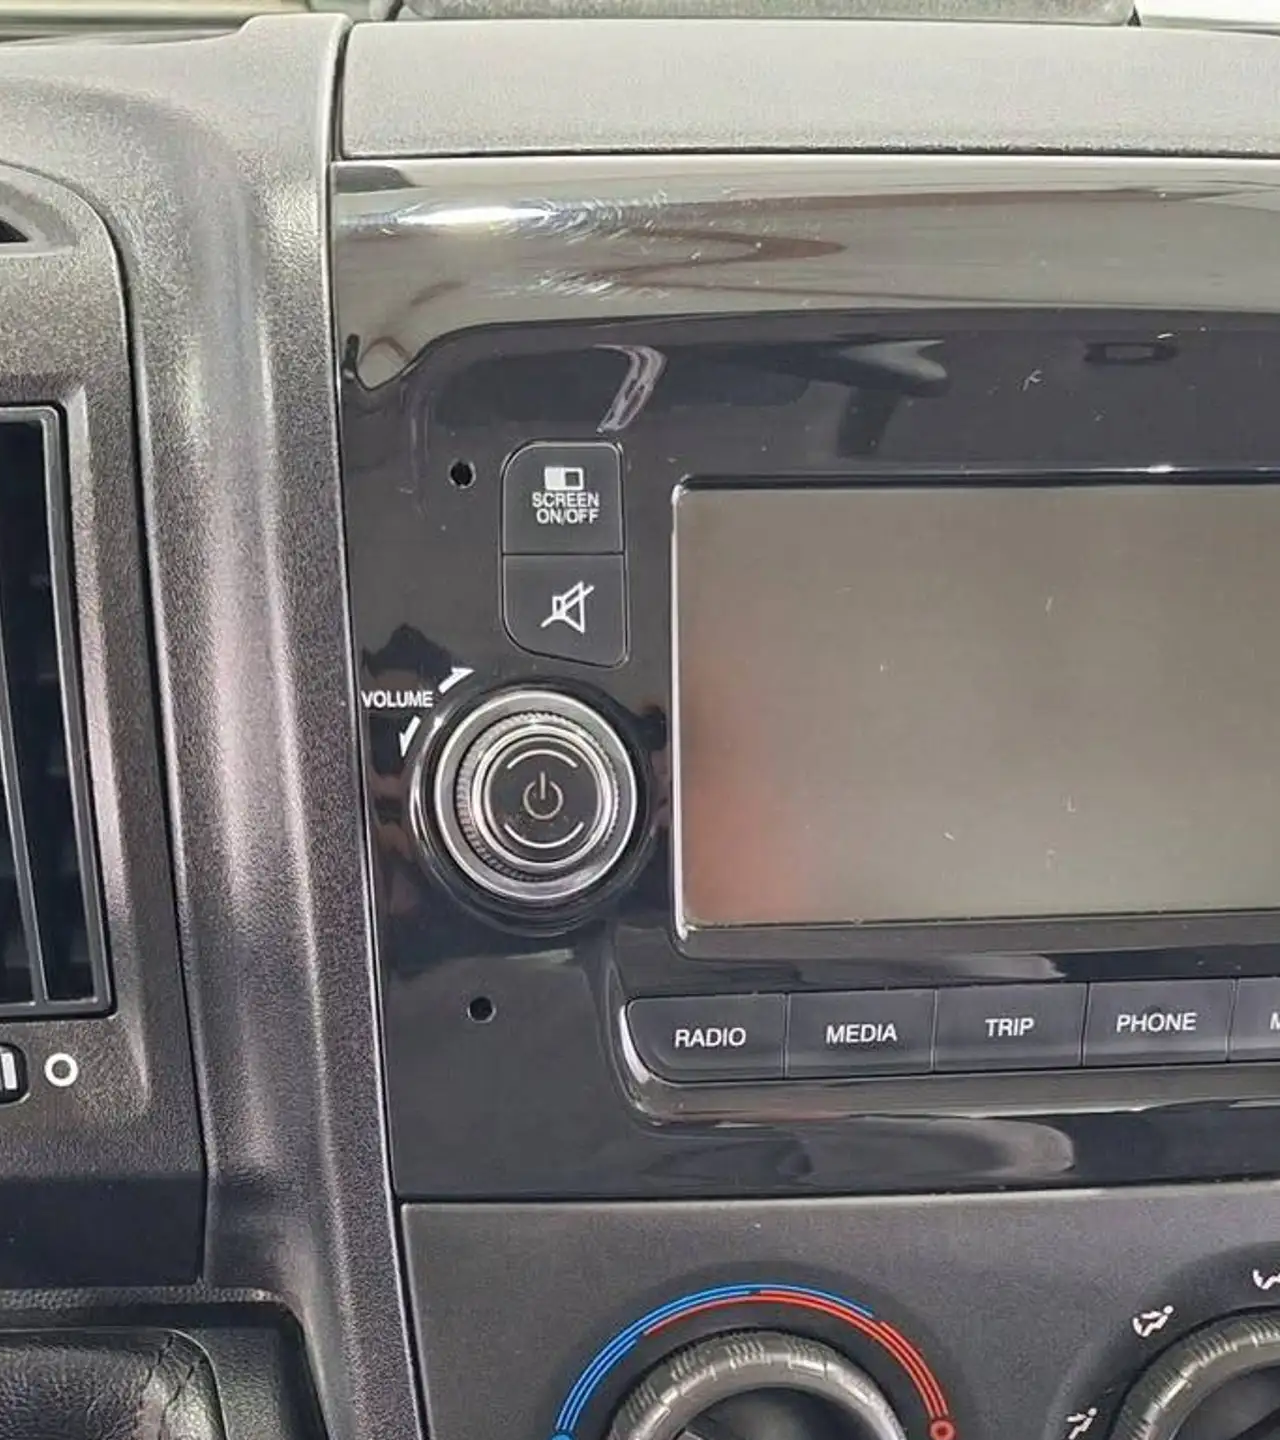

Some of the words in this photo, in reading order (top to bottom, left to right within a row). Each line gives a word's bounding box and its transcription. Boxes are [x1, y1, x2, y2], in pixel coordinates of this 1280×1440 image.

[532, 490, 600, 509] SCREEN
[536, 507, 599, 524] ON/OFF
[360, 690, 434, 708] VOLUME
[984, 1017, 1035, 1037] TRIP
[1116, 1011, 1197, 1033] PHONE
[674, 1027, 747, 1048] RADIO
[826, 1023, 898, 1044] MEDIA
